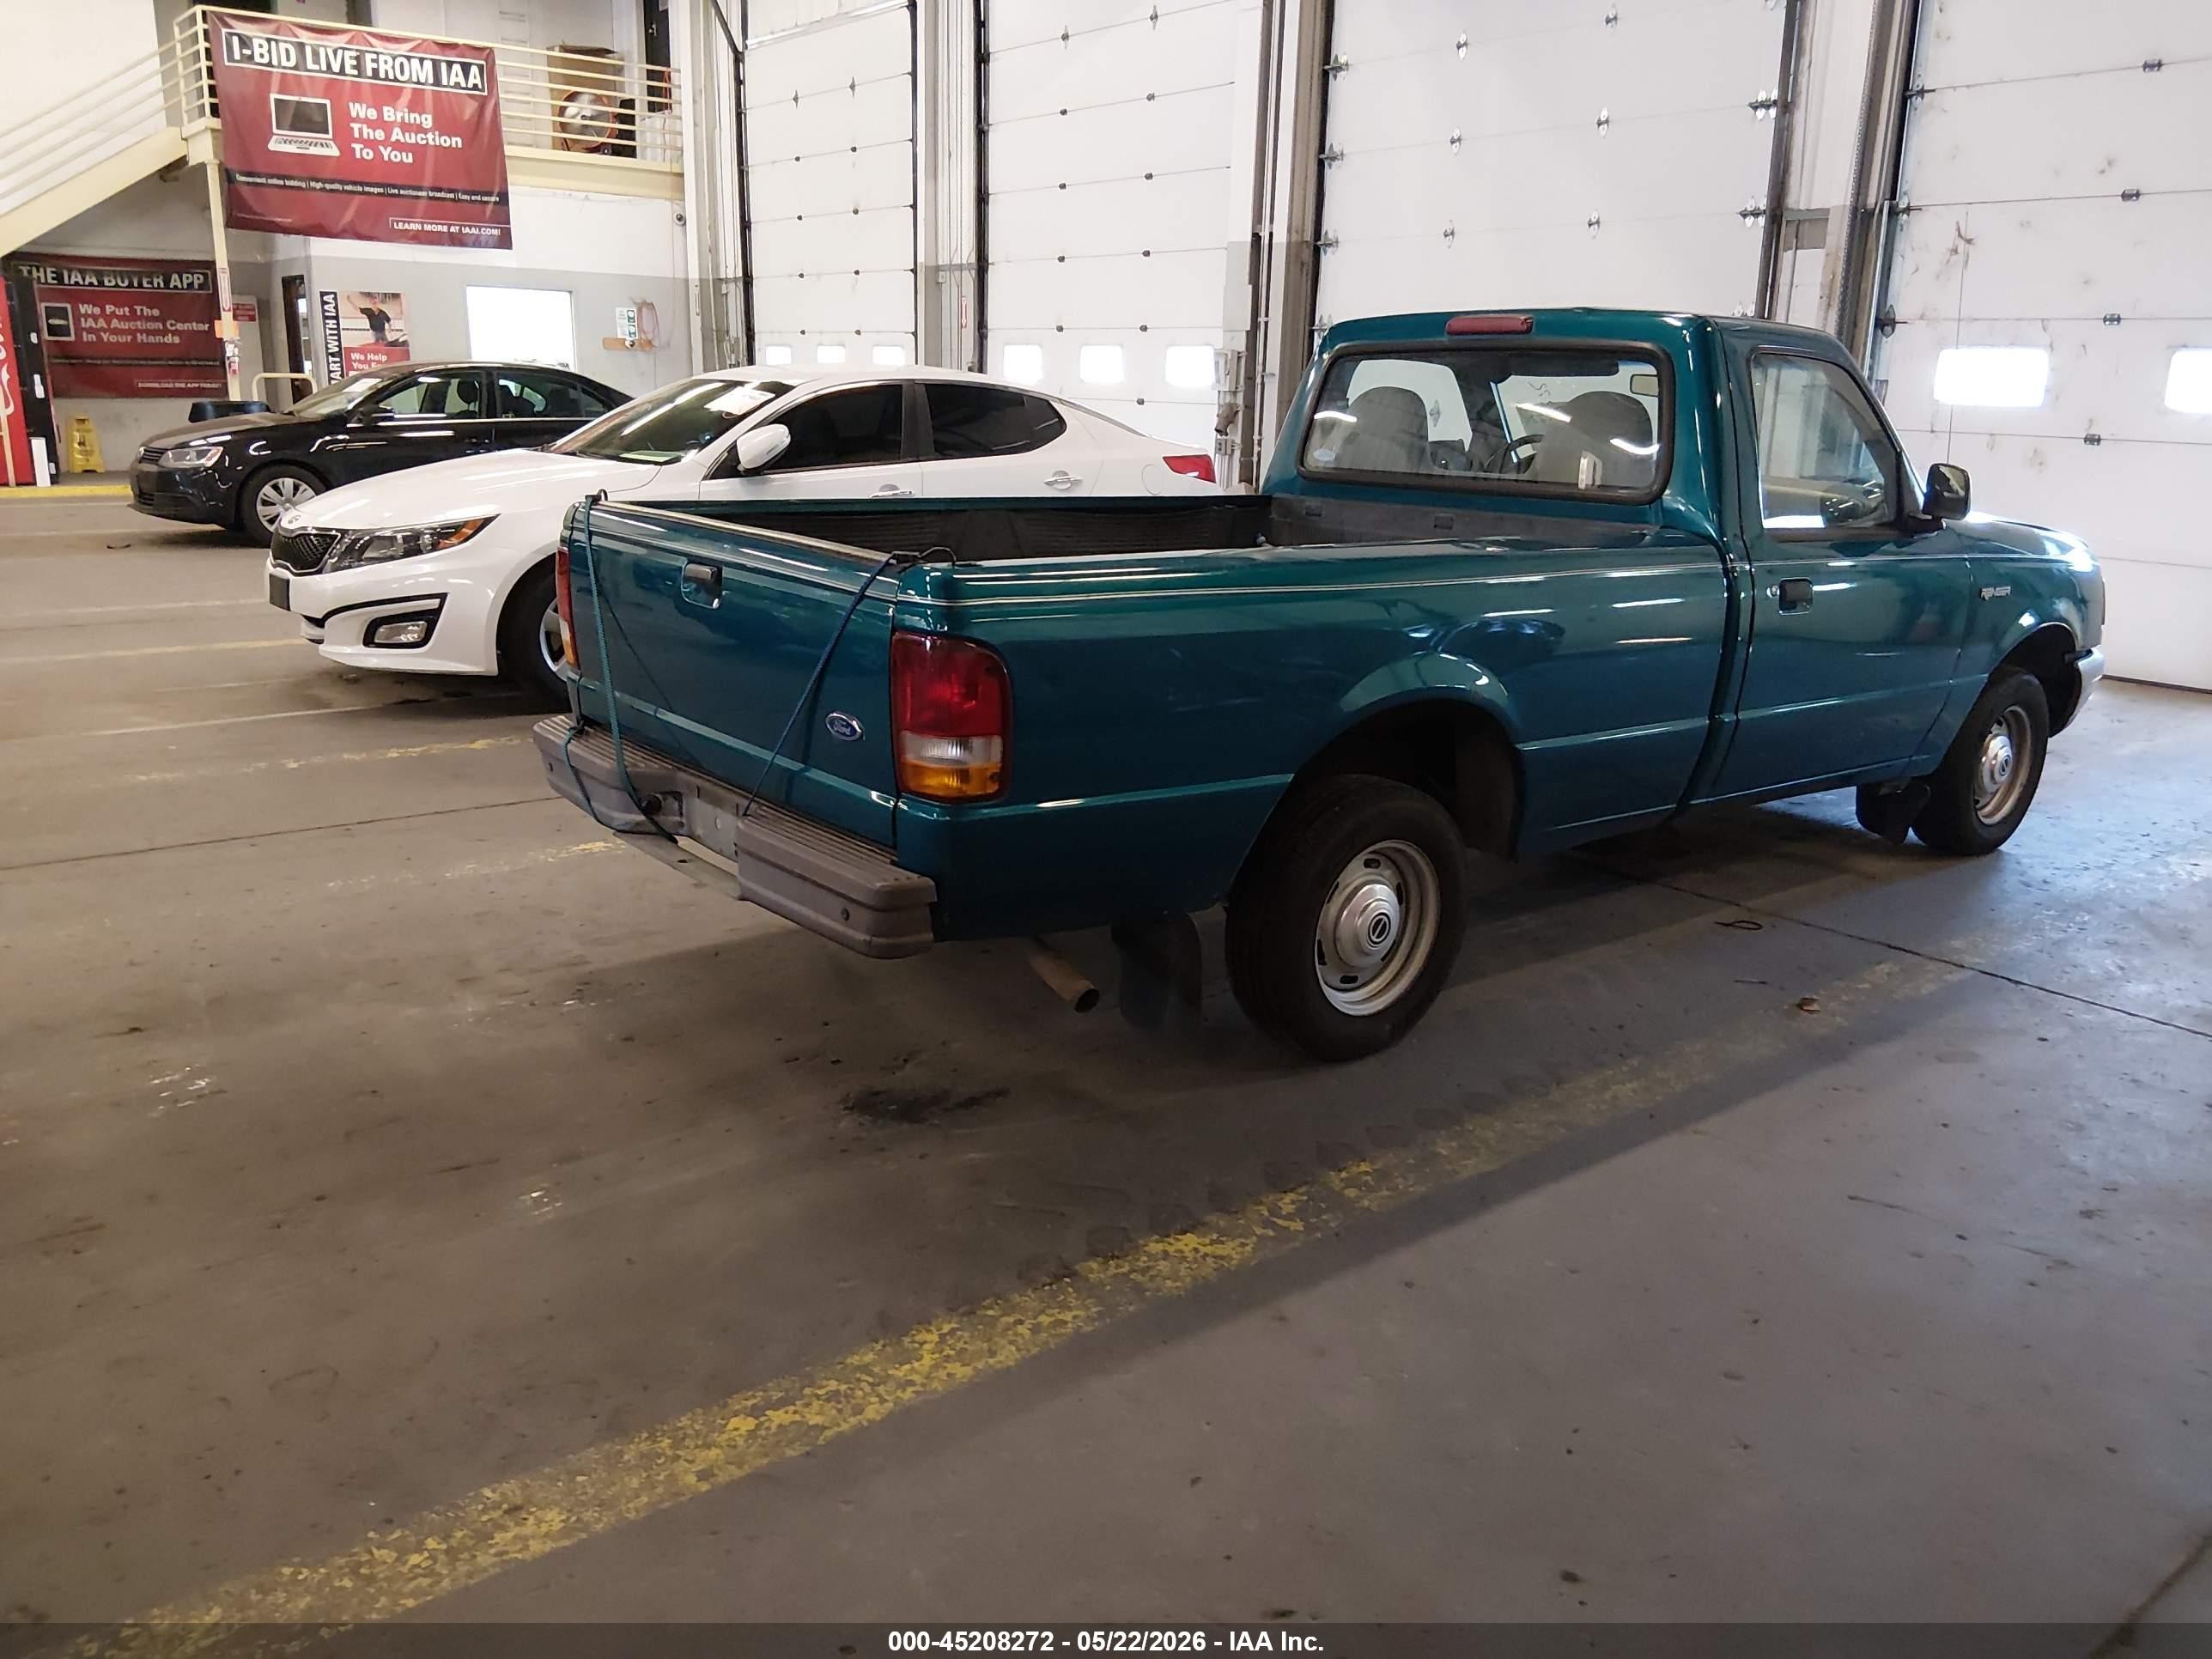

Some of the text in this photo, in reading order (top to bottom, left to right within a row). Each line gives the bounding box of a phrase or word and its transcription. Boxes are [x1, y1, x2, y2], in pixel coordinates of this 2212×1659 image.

[232, 35, 483, 89] I-BID LIVE FROM IAA
[349, 101, 433, 129] We Bring
[349, 123, 463, 149] The Auction
[351, 143, 414, 164] To You
[393, 221, 422, 231] LEARN
[423, 224, 448, 234] MORE
[19, 265, 204, 289] THE IAA BUYER APP
[78, 303, 160, 317] We Put The
[323, 294, 337, 317] IAA
[81, 318, 210, 331] IAA Auction Center
[82, 331, 180, 344] In Your Hands
[325, 319, 340, 354] WITH
[350, 352, 388, 362] We Help
[352, 362, 369, 370] You
